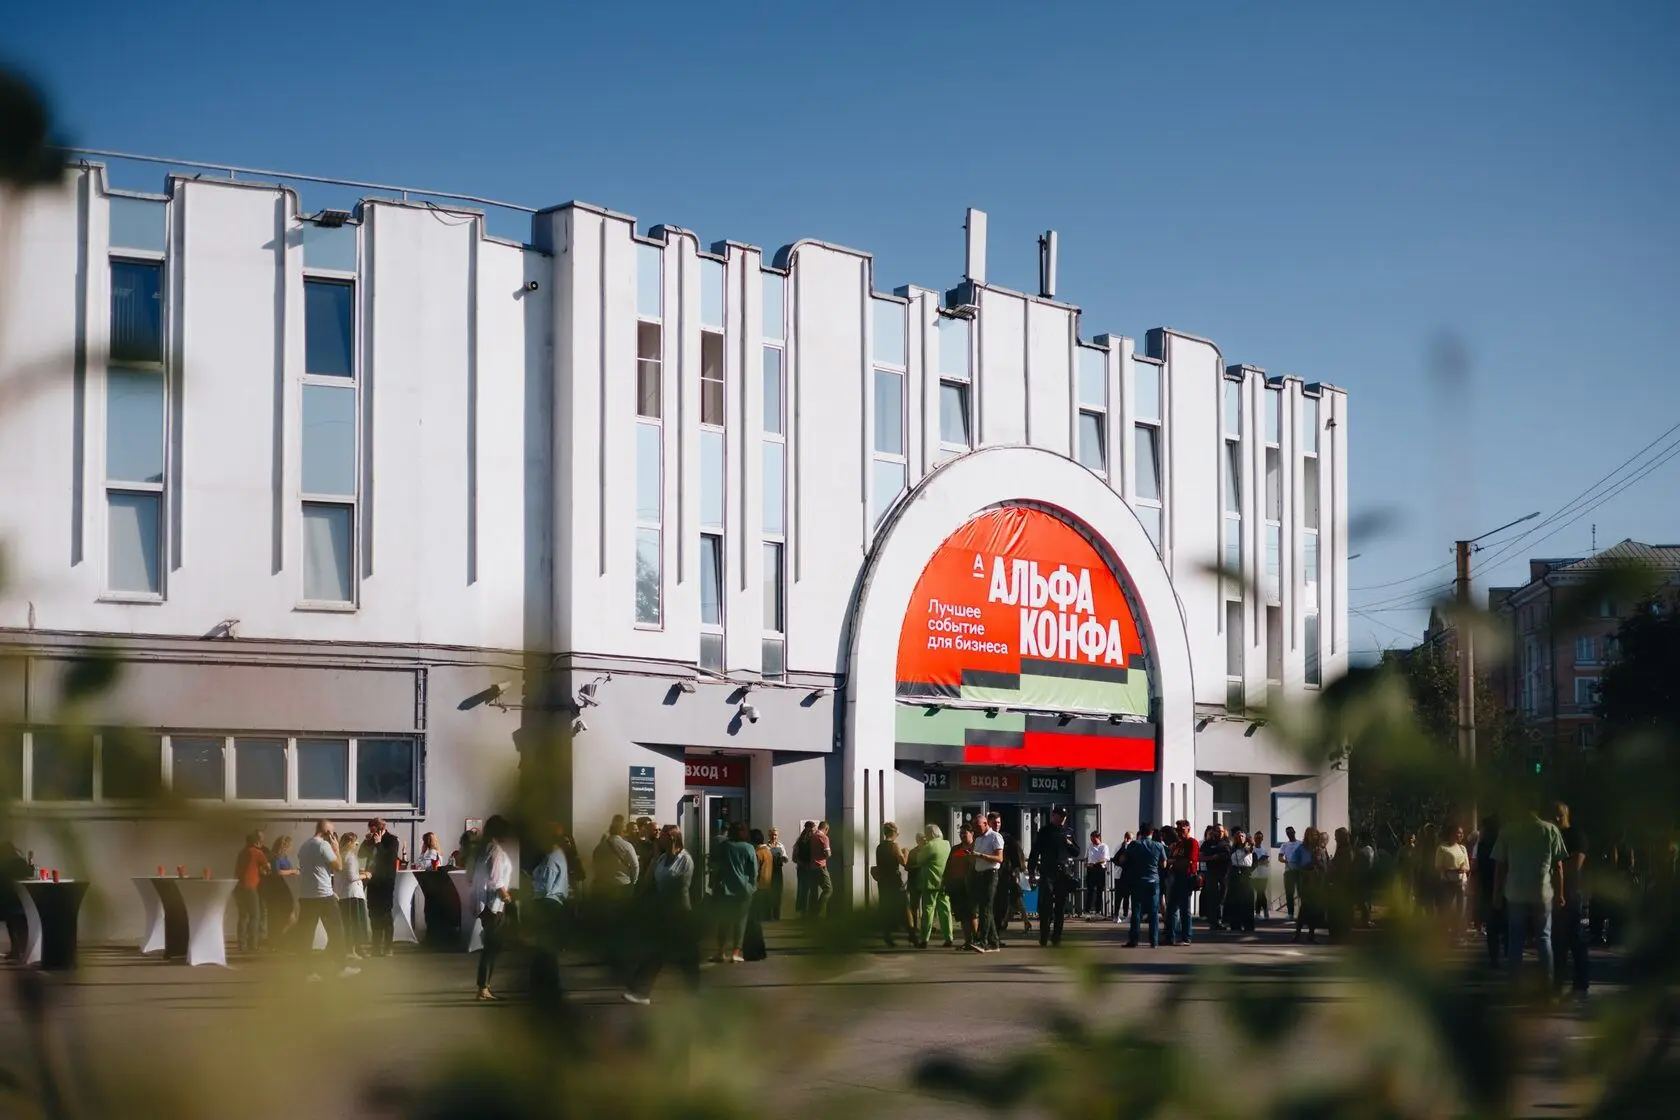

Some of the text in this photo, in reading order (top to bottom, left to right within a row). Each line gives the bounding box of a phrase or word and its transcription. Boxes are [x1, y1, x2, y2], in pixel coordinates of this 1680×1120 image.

[988, 556, 1095, 614] АЛЬФА
[927, 599, 982, 619] Лучшее
[927, 619, 985, 635] событие
[1019, 608, 1124, 665] КОНФА
[927, 635, 1009, 655] для бизнеса
[685, 765, 728, 779] ВХОД 1
[940, 774, 946, 784] 2
[970, 776, 1008, 788] ВХОД 3
[1032, 778, 1067, 790] ВХОД 4
